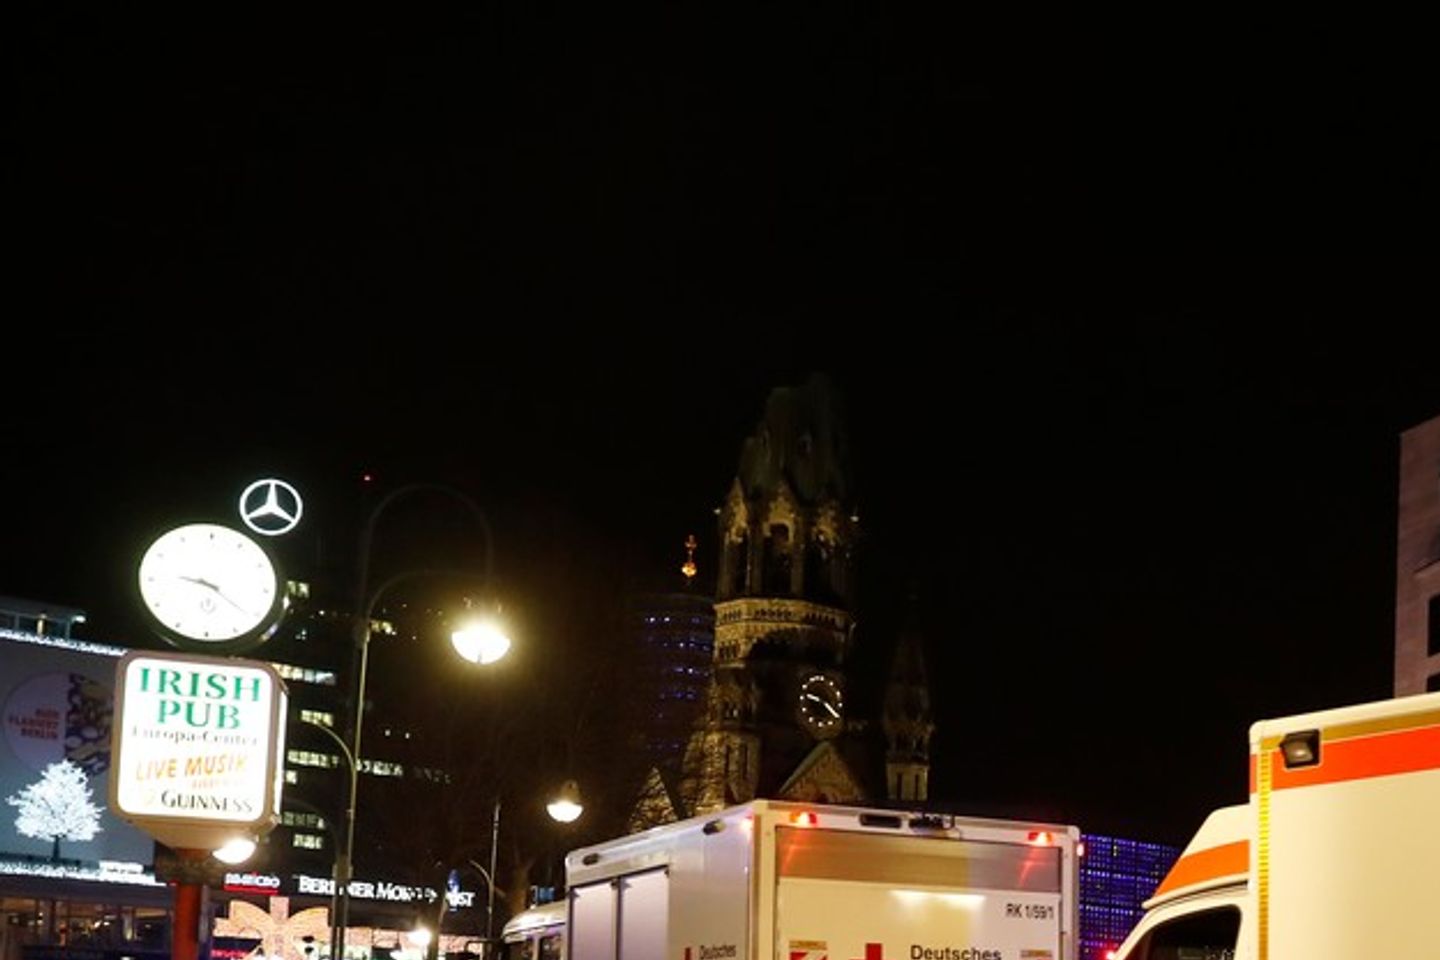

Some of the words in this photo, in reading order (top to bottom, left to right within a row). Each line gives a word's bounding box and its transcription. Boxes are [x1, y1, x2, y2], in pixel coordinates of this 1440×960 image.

[138, 667, 262, 701] IRISH
[157, 699, 240, 729] PUB
[136, 757, 178, 781] LIVE
[184, 753, 248, 777] MUSIK
[161, 789, 253, 813] GUINNESS
[1005, 903, 1022, 919] RK
[699, 943, 737, 960] Deutsches
